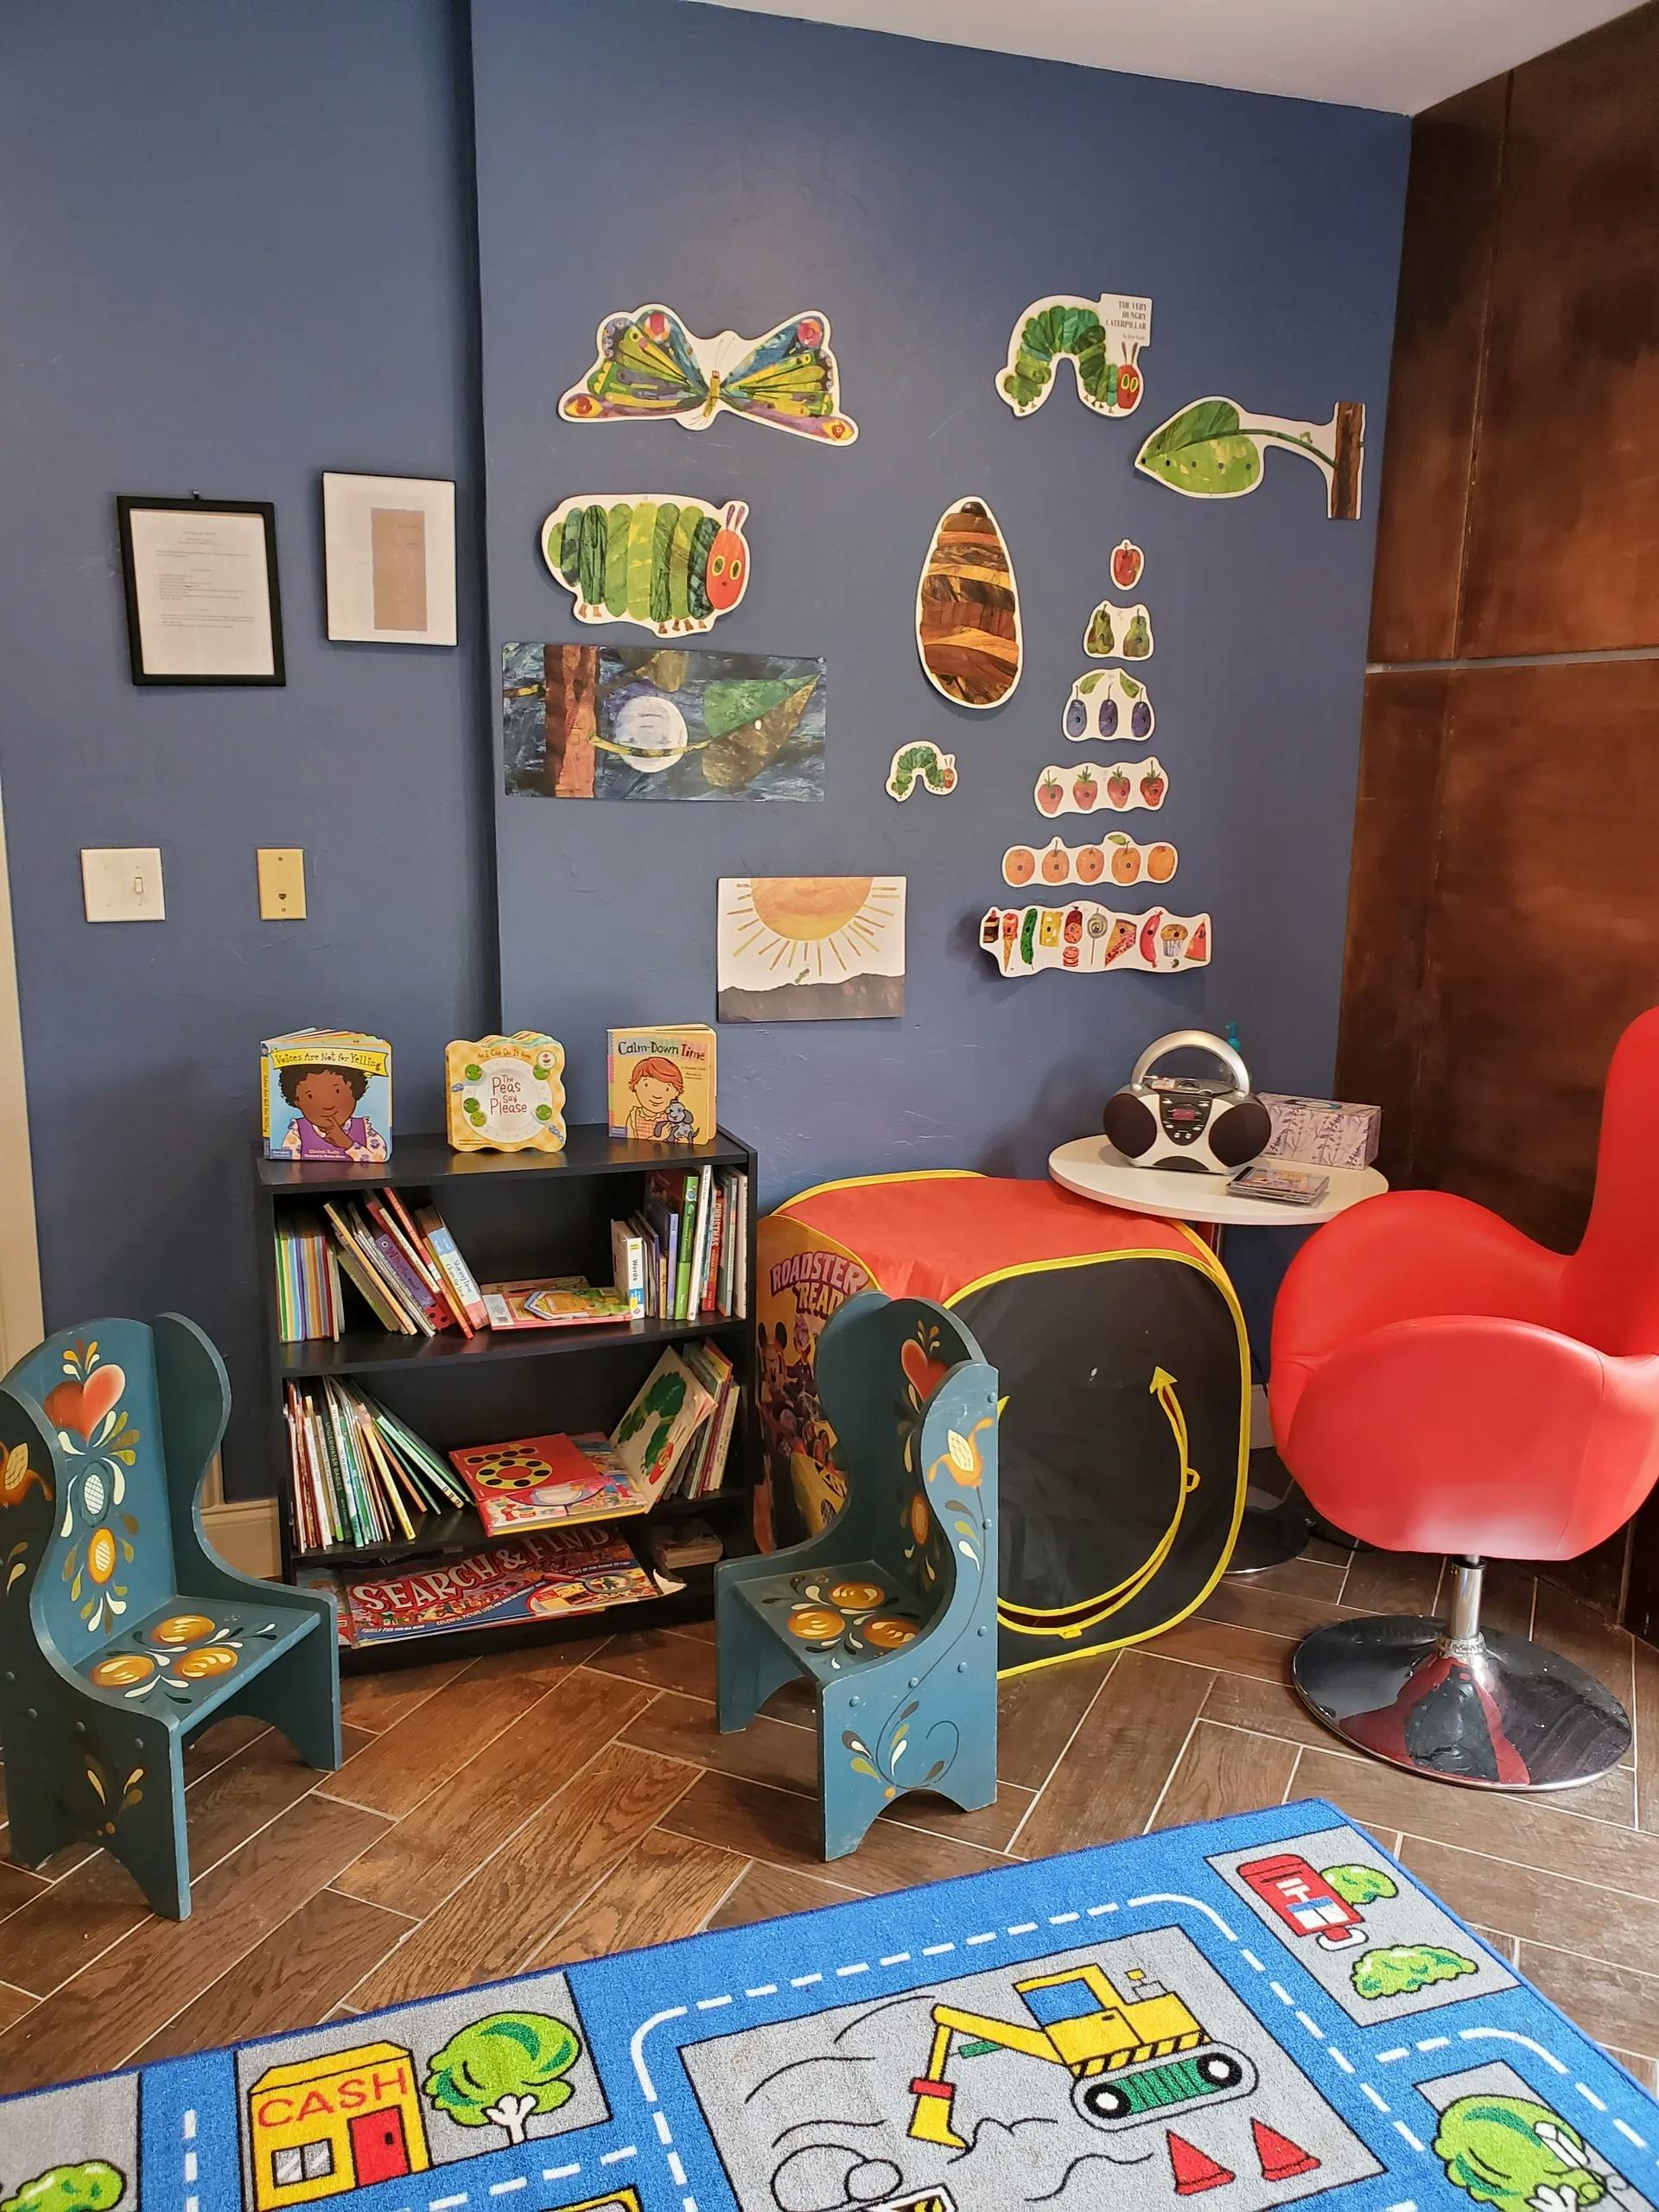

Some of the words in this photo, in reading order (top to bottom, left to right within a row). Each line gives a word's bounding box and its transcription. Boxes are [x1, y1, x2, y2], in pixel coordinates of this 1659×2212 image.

[1118, 301, 1129, 309] THE
[1132, 302, 1147, 311] VERY
[1106, 319, 1147, 330] CATERPILLAR
[1122, 311, 1146, 321] HUNGRY
[618, 1041, 679, 1055] Calm-Down
[681, 1043, 706, 1061] Time
[276, 1053, 302, 1064] Voices
[304, 1052, 320, 1061] Are
[321, 1052, 336, 1062] Not
[350, 1052, 381, 1071] Yelling
[492, 1077, 521, 1095] Peas
[502, 1074, 514, 1083] The
[490, 1098, 528, 1116] Please
[711, 1202, 722, 1247] CHRISTMAS
[772, 1252, 869, 1297] ROADSTER
[793, 1281, 846, 1314] READ
[325, 1421, 339, 1470] UNDERWATER
[352, 1554, 499, 1611] SEARCH
[496, 1548, 528, 1569] &
[524, 1526, 610, 1560] FIND
[257, 2068, 407, 2127] CASH
